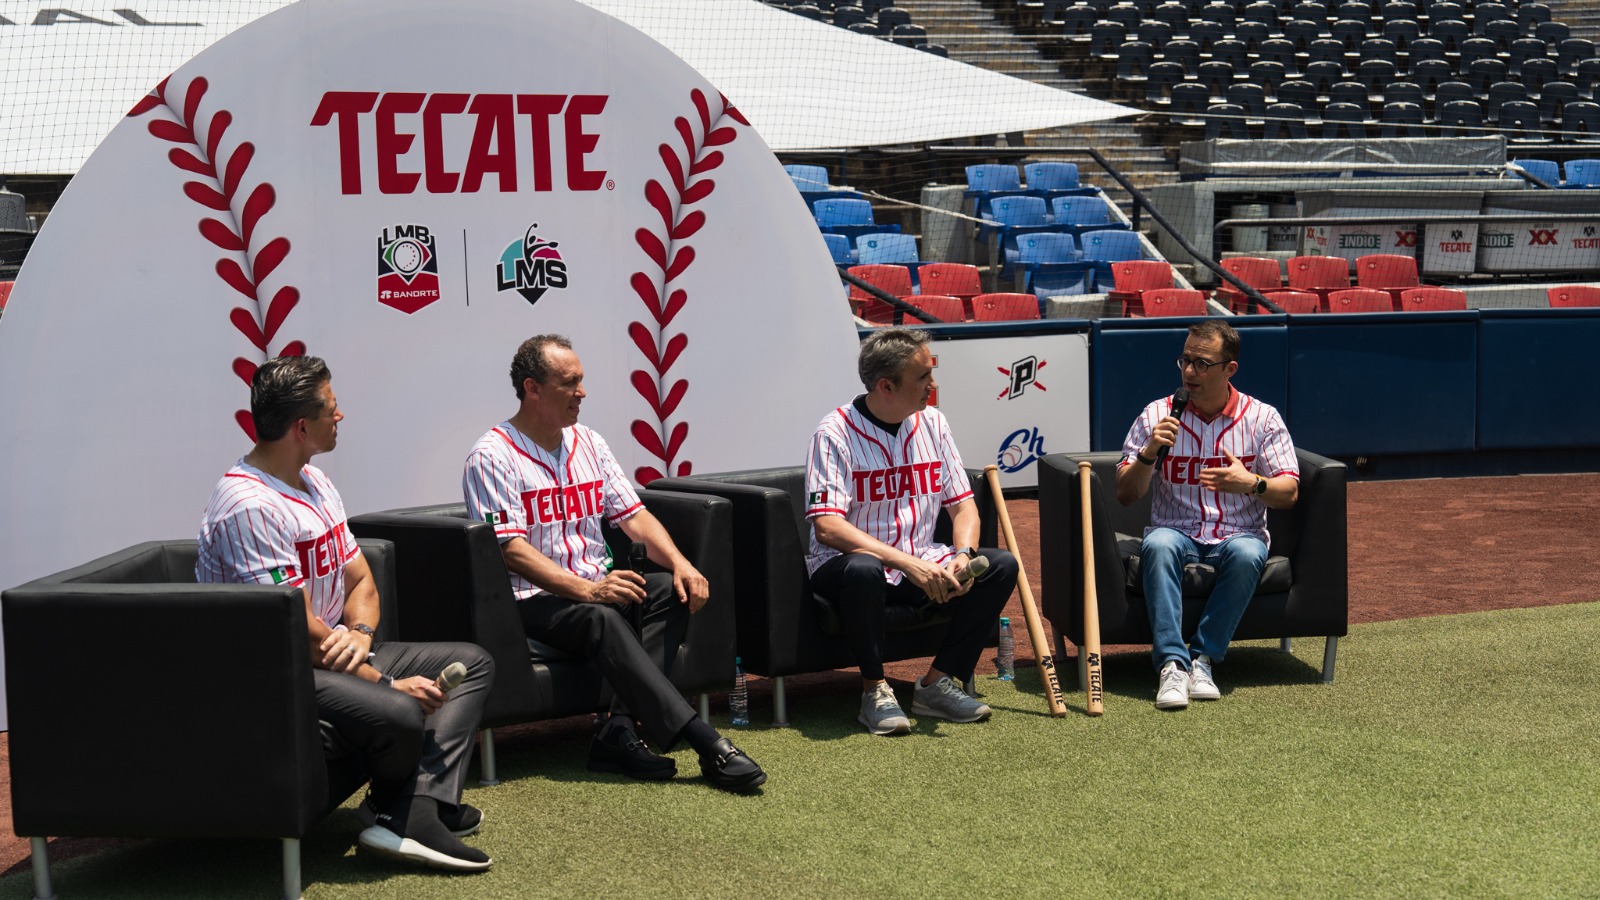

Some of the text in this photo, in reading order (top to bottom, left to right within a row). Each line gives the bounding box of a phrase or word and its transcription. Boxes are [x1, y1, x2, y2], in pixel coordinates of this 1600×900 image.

[0, 8, 204, 26] AL
[309, 91, 609, 195] TECATE
[383, 225, 430, 246] LMB
[1344, 235, 1377, 248] INDIO
[1481, 235, 1509, 248] NDIO
[1528, 229, 1559, 246] XX
[1572, 238, 1600, 249] TECAT
[1440, 242, 1472, 253] TECATE
[497, 259, 568, 292] LMS
[393, 290, 438, 298] BANORTE
[1163, 455, 1257, 485] TEC
[852, 461, 943, 503] TECATE
[521, 479, 605, 526] TECATE
[1048, 670, 1063, 705] TECATE
[1090, 669, 1102, 704] TECATE
